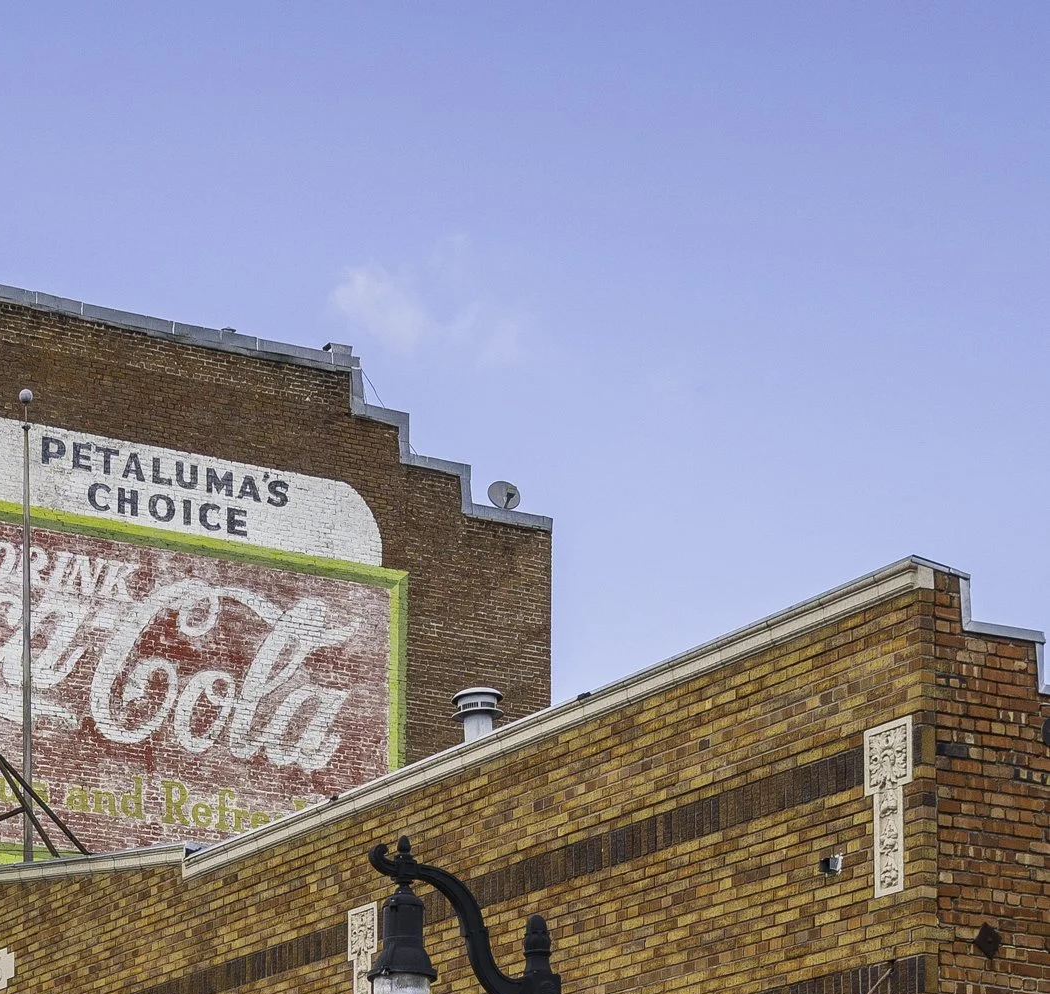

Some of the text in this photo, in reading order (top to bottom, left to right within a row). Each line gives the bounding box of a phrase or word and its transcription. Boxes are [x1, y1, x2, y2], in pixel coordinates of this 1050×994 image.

[40, 435, 290, 507] PETALUMA'S
[87, 482, 248, 537] CHOICE
[66, 775, 145, 820] and
